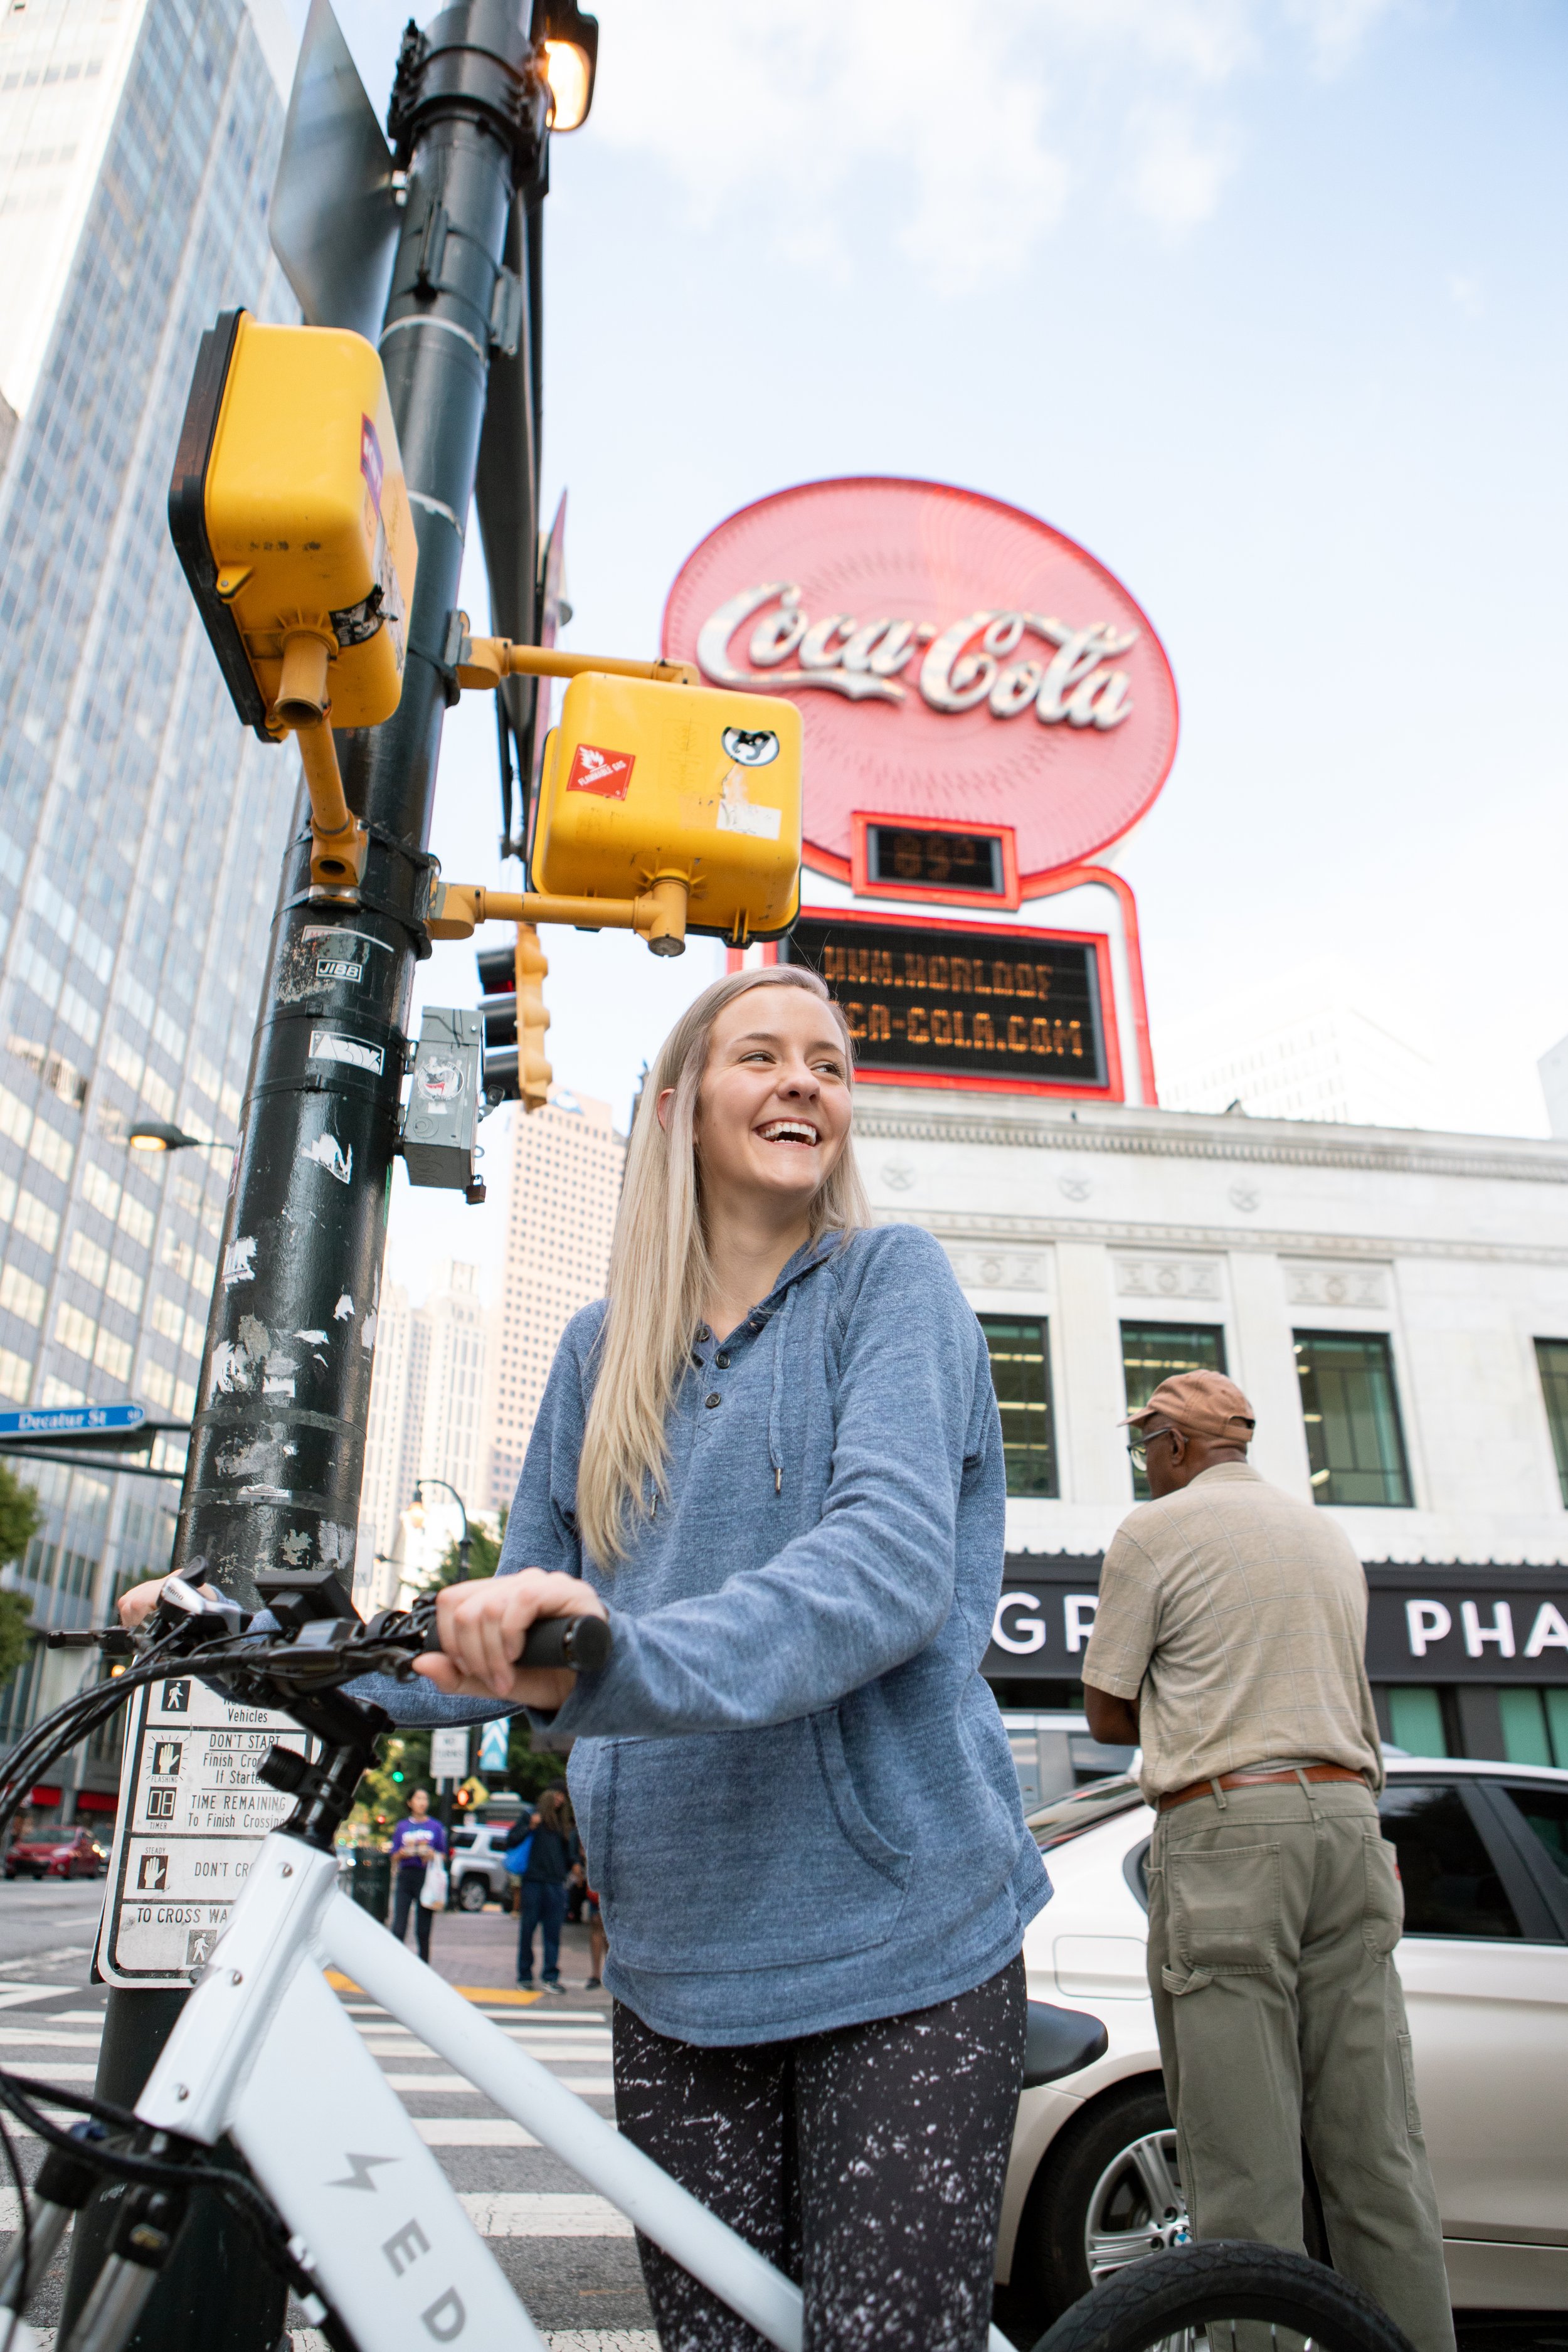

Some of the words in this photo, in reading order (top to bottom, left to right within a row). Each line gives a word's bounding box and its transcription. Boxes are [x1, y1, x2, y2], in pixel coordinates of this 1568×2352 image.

[696, 580, 1140, 731] Coca-Cola
[577, 765, 613, 787] FLAMMABLE
[612, 760, 627, 772] GAS
[319, 962, 359, 978] JIBB
[830, 1000, 1083, 1057] CA-COLA.COM
[18, 1412, 85, 1430] Decatur
[88, 1409, 107, 1427] St
[1405, 1599, 1568, 1658] PHA
[228, 1708, 268, 1723] Vehicles
[209, 1734, 243, 1749] DON'T
[248, 1735, 281, 1749] START
[203, 1752, 233, 1767] Finish
[241, 1754, 258, 1767] Cro
[151, 1776, 179, 1784] FLASHING
[215, 1769, 224, 1784] If
[191, 1794, 217, 1810] TIME
[223, 1795, 287, 1811] REMAINING
[149, 1821, 167, 1830] TIMER
[188, 1812, 199, 1827] To
[206, 1813, 236, 1828] Finish
[145, 1846, 166, 1855] STEADY
[194, 1862, 229, 1877] DON'T
[137, 1907, 152, 1924] TO
[157, 1908, 201, 1924] CROSS
